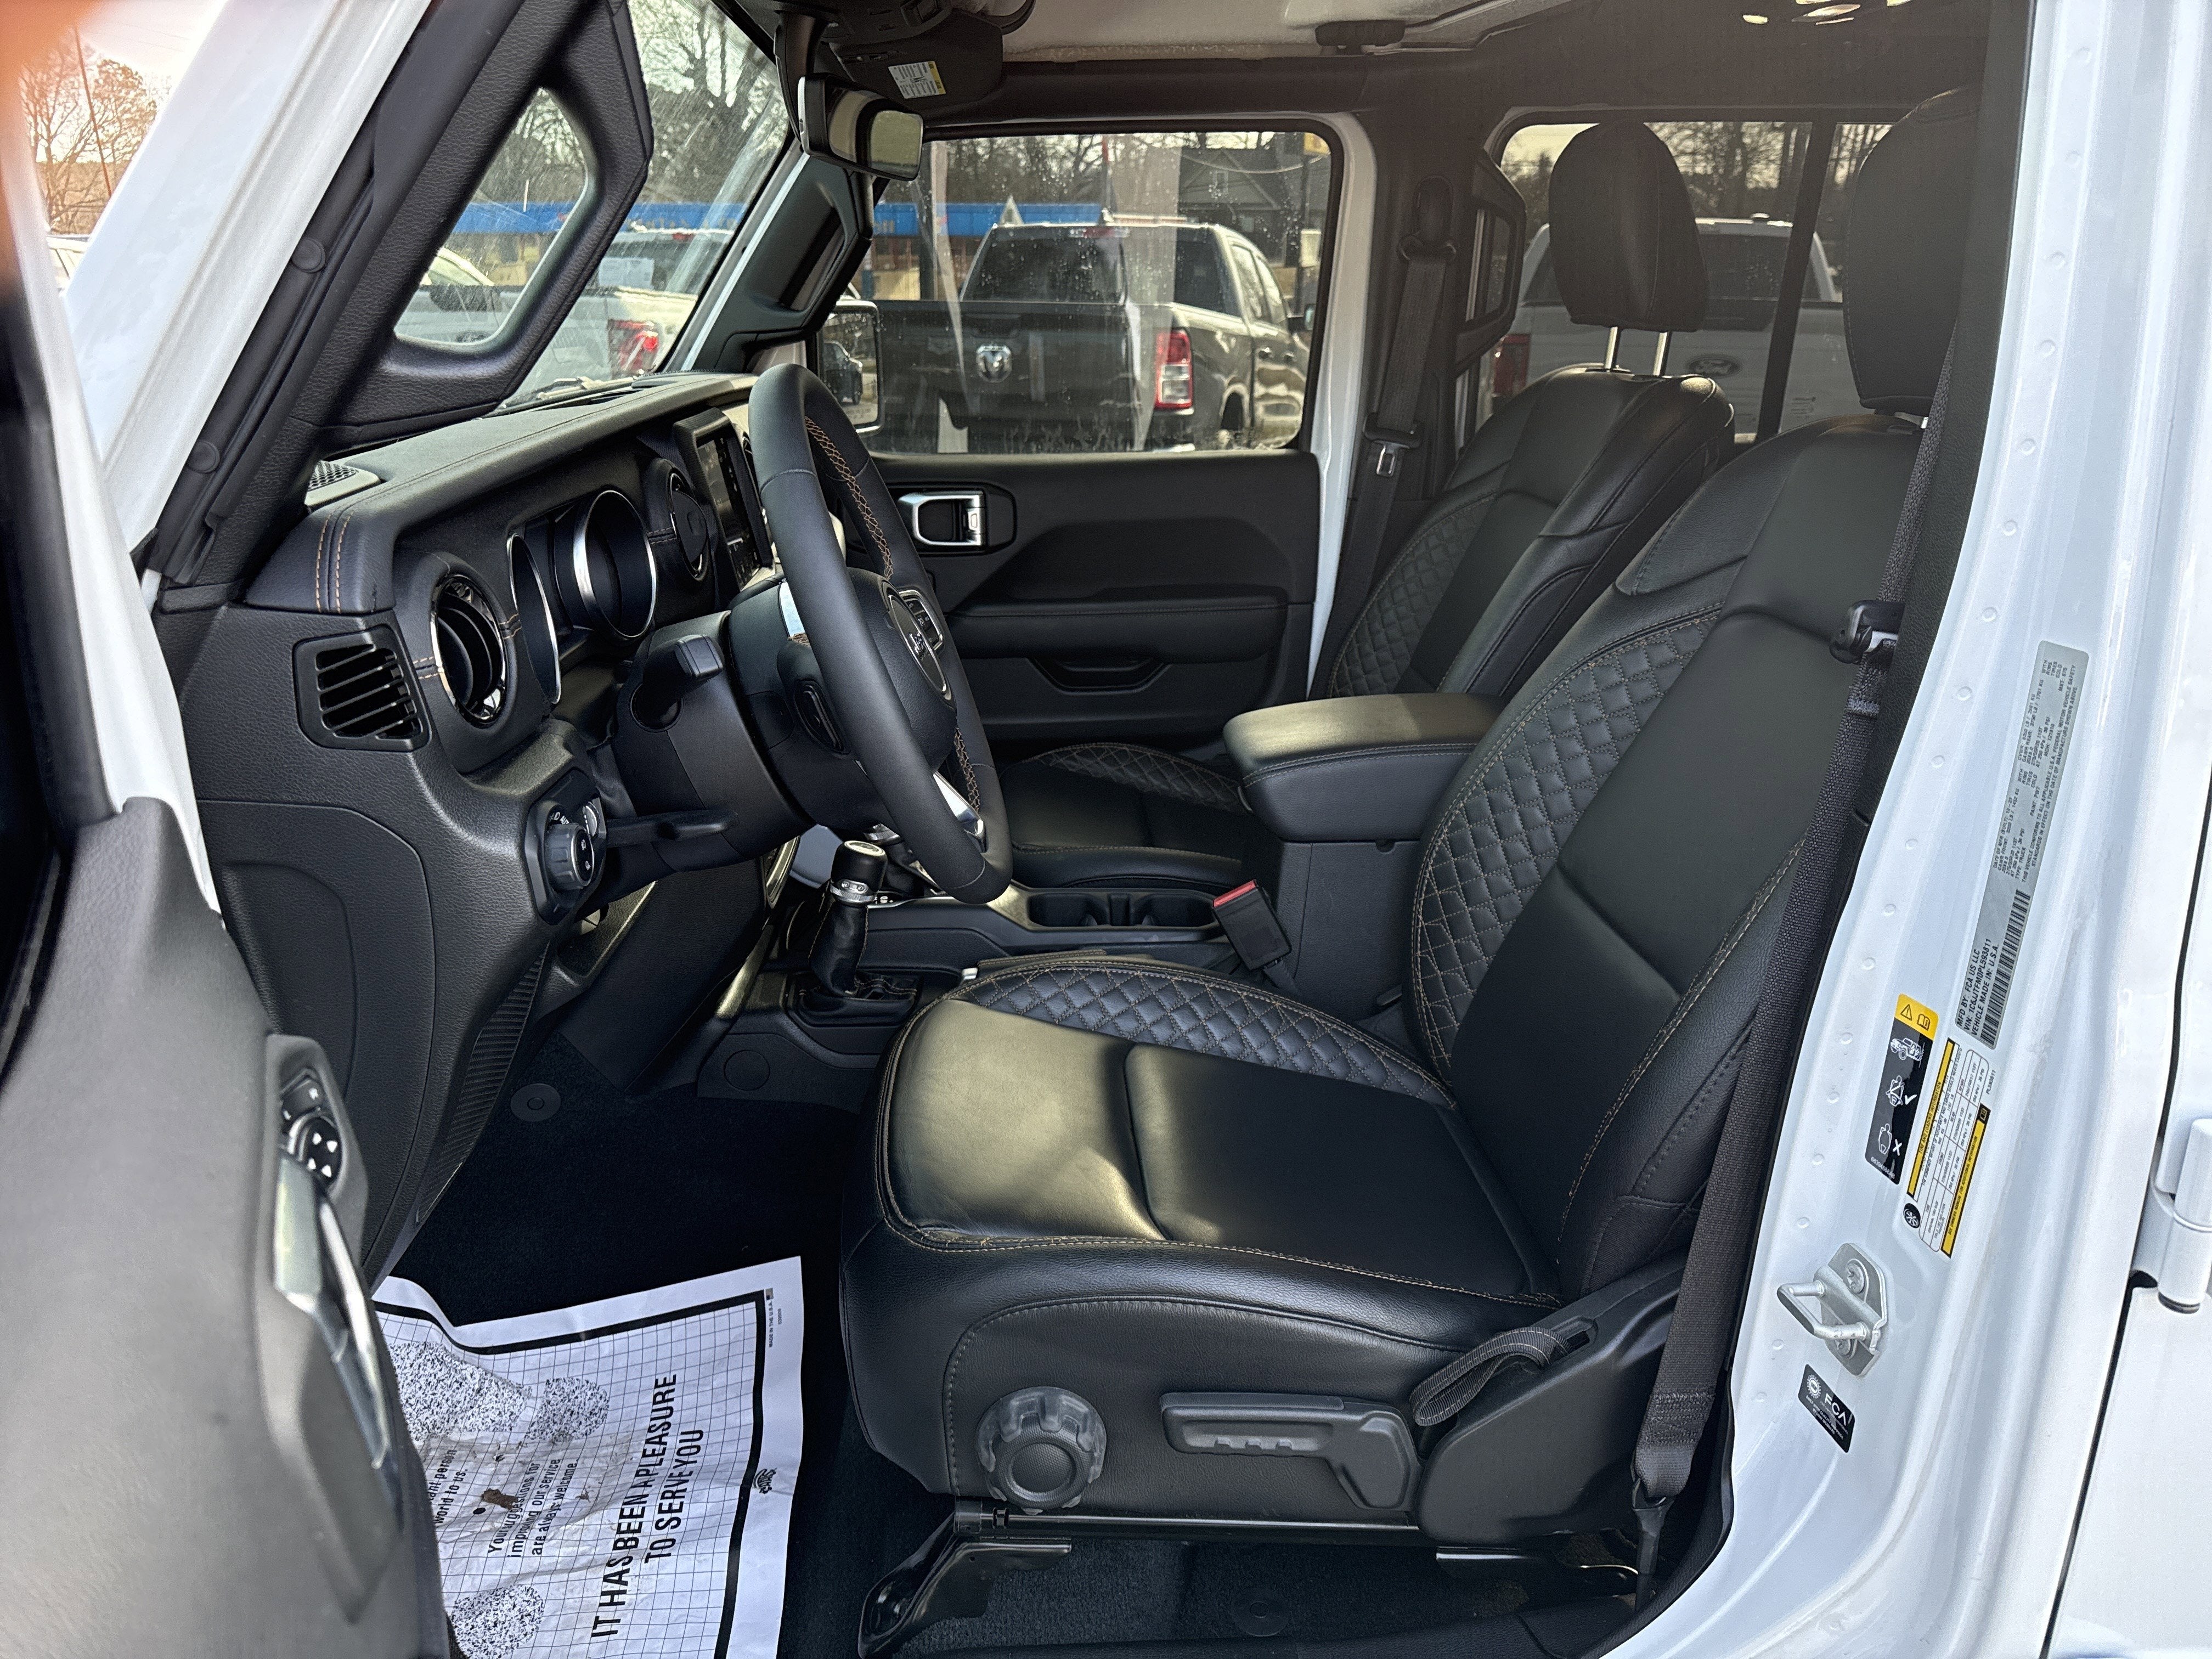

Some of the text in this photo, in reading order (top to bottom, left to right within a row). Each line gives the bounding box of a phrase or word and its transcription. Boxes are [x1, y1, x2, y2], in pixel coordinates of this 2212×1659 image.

[2025, 850, 2033, 870] VEHICLE
[2030, 822, 2040, 849] CONFORMS
[2041, 772, 2052, 802] APPLICABLE
[2052, 730, 2062, 753] FEDERAL
[2063, 686, 2072, 708] VEHICLE
[2032, 837, 2042, 867] STANDARDS
[2040, 810, 2049, 829] EFFECT
[2045, 801, 2051, 809] ON
[2056, 727, 2068, 765] MANUFACTURE
[2065, 706, 2073, 725] SHOWN
[1956, 949, 1980, 1026] MFD BY: FCA US LLC
[1964, 1015, 1973, 1030] VIN:
[1972, 1005, 1984, 1035] VEHICLE
[1979, 981, 1990, 1004] MADE
[1988, 944, 2000, 967] U.S.A.
[1931, 1081, 1941, 1113] INFORMATION
[1825, 1393, 1847, 1426] FCA
[433, 1498, 453, 1524] world
[445, 1485, 459, 1494] to
[453, 1469, 468, 1482] us.
[435, 1449, 457, 1480] person
[532, 1491, 545, 1505] our
[541, 1459, 560, 1489] service
[591, 1374, 677, 1637] IT HAS BEEN A PLEASURE
[645, 1430, 704, 1563] TO SERVE YOU
[488, 1528, 507, 1554] Your
[525, 1463, 540, 1475] for
[532, 1536, 546, 1555] are
[555, 1459, 579, 1502] welcome.
